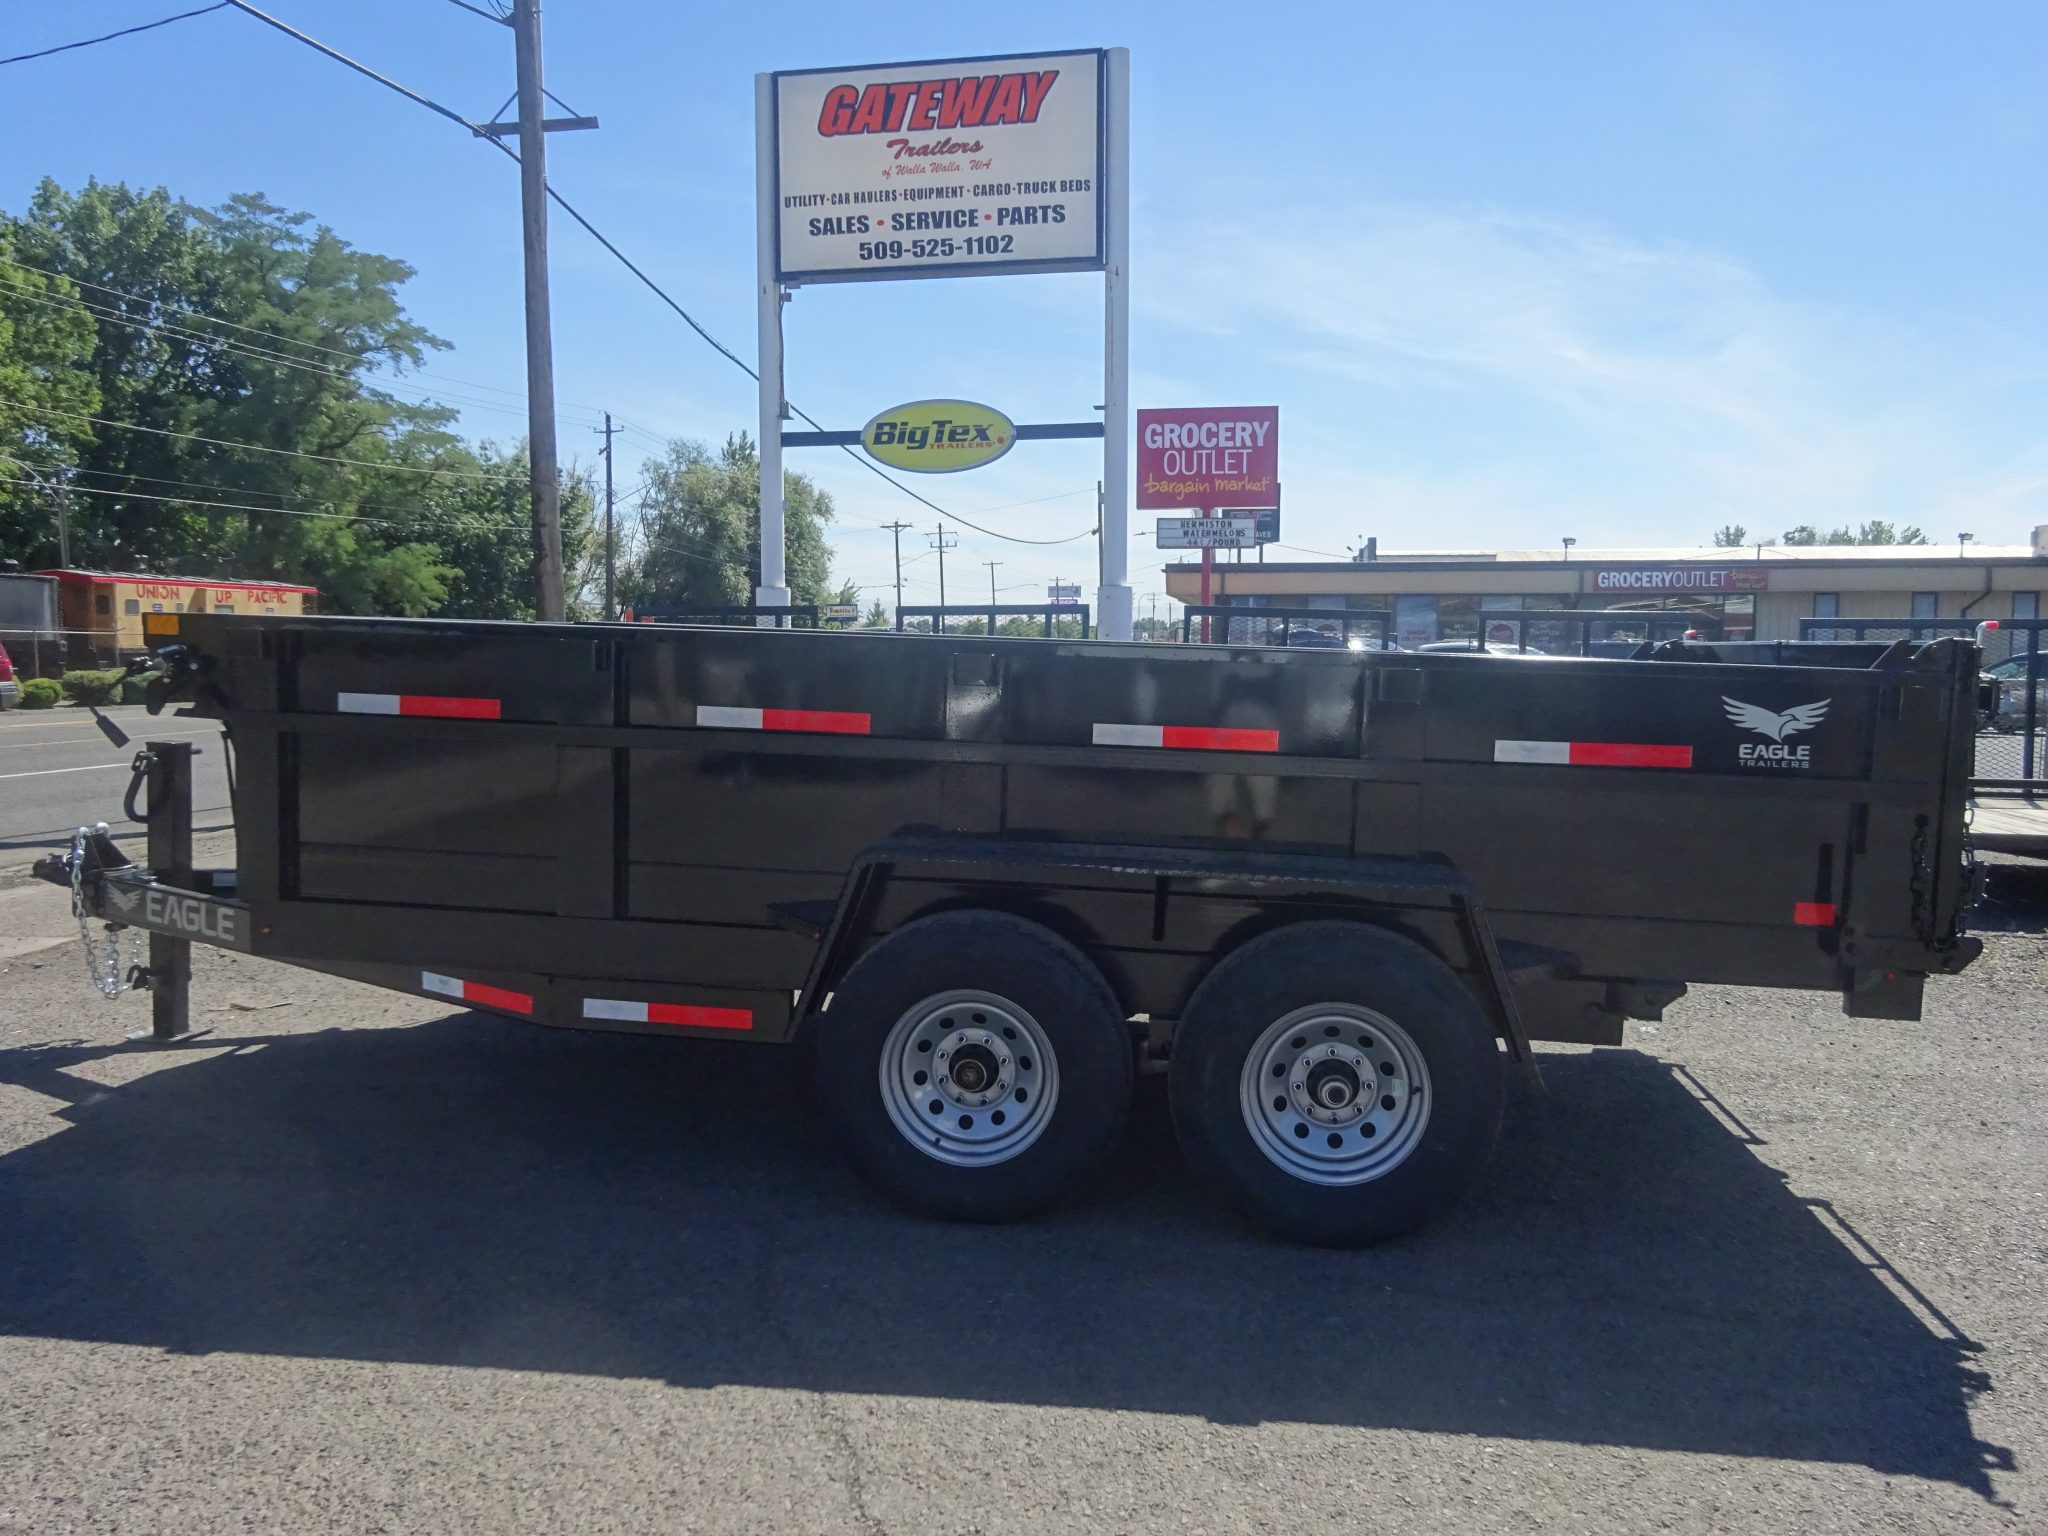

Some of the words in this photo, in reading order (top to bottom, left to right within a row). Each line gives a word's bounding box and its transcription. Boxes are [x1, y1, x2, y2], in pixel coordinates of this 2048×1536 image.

[818, 70, 1060, 137] GATEWAY
[886, 137, 984, 160] Trailers
[881, 166, 892, 180] of
[895, 163, 926, 176] Walla
[969, 158, 992, 171] WA
[784, 194, 826, 208] UTILITY
[831, 193, 851, 206] CAR
[853, 189, 898, 204] HAULERS
[903, 185, 965, 201] EQUIPMENT
[972, 183, 1011, 197] CARGO
[1016, 180, 1057, 195] TRUCK
[1060, 179, 1091, 193] BEDS
[808, 215, 870, 237] SALES
[891, 208, 979, 232] SERVICE
[997, 204, 1066, 226] PARTS
[858, 234, 1014, 261] 509-525-1102
[929, 441, 993, 450] TRAILERS
[1144, 421, 1271, 449] GROCERY
[1163, 449, 1253, 476] OUTLET
[1143, 472, 1210, 501] bargain
[1214, 475, 1270, 492] market
[1180, 520, 1233, 529] HERMISTON
[1182, 529, 1246, 538] WATERMELONS
[136, 584, 180, 600] UNION
[214, 590, 233, 603] UP
[247, 590, 288, 604] PACIFIC
[1738, 743, 1811, 760] EAGLE
[1738, 759, 1810, 769] TRAILERS
[145, 890, 236, 942] EAGLE
